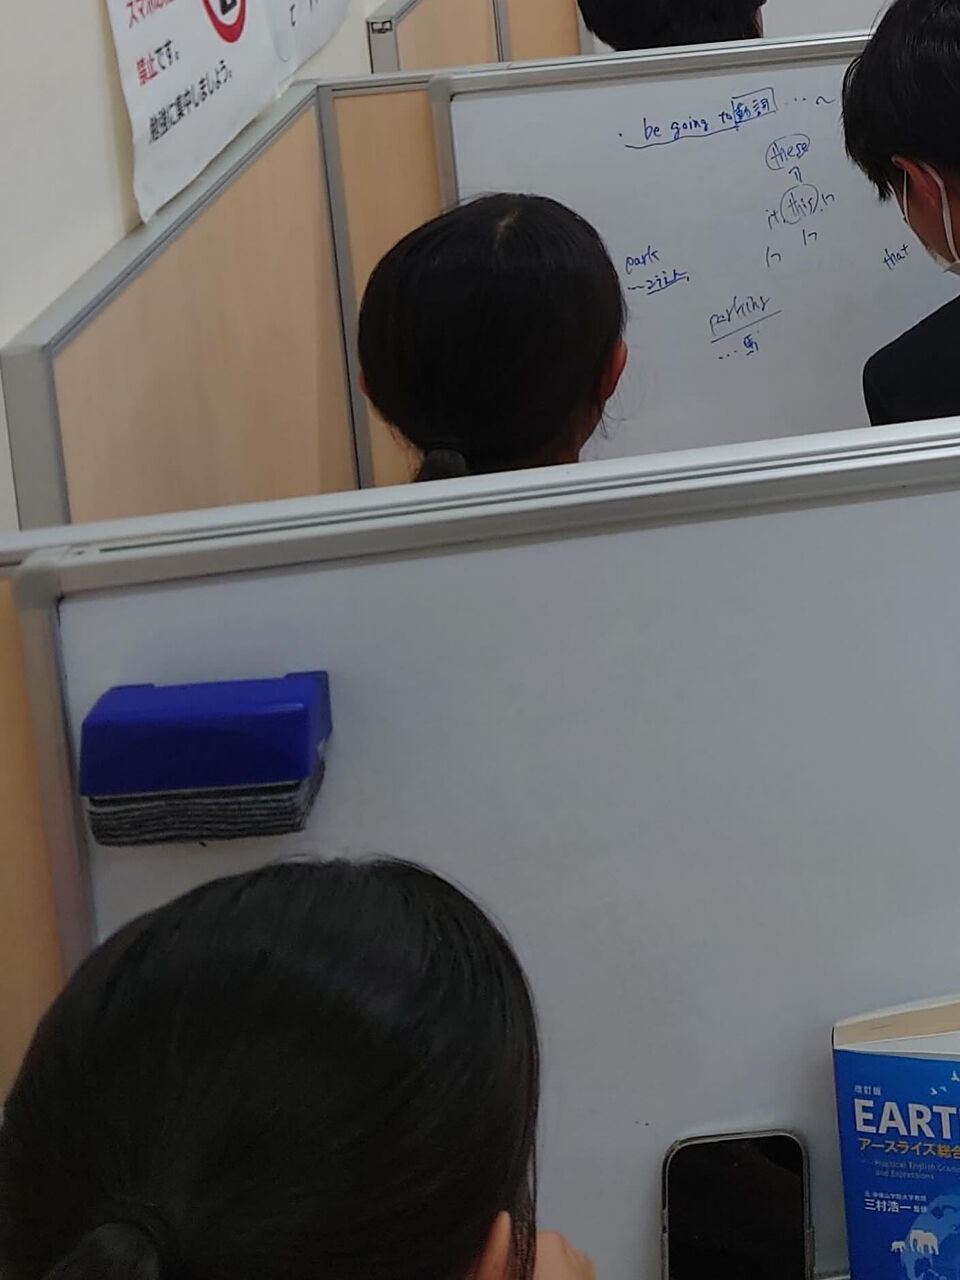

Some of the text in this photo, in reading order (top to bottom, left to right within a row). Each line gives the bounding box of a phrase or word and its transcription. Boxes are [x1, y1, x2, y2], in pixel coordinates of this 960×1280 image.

[643, 117, 662, 140] be
[671, 116, 709, 142] going
[625, 245, 660, 275] park
[864, 1198, 912, 1213] 三村浩一
